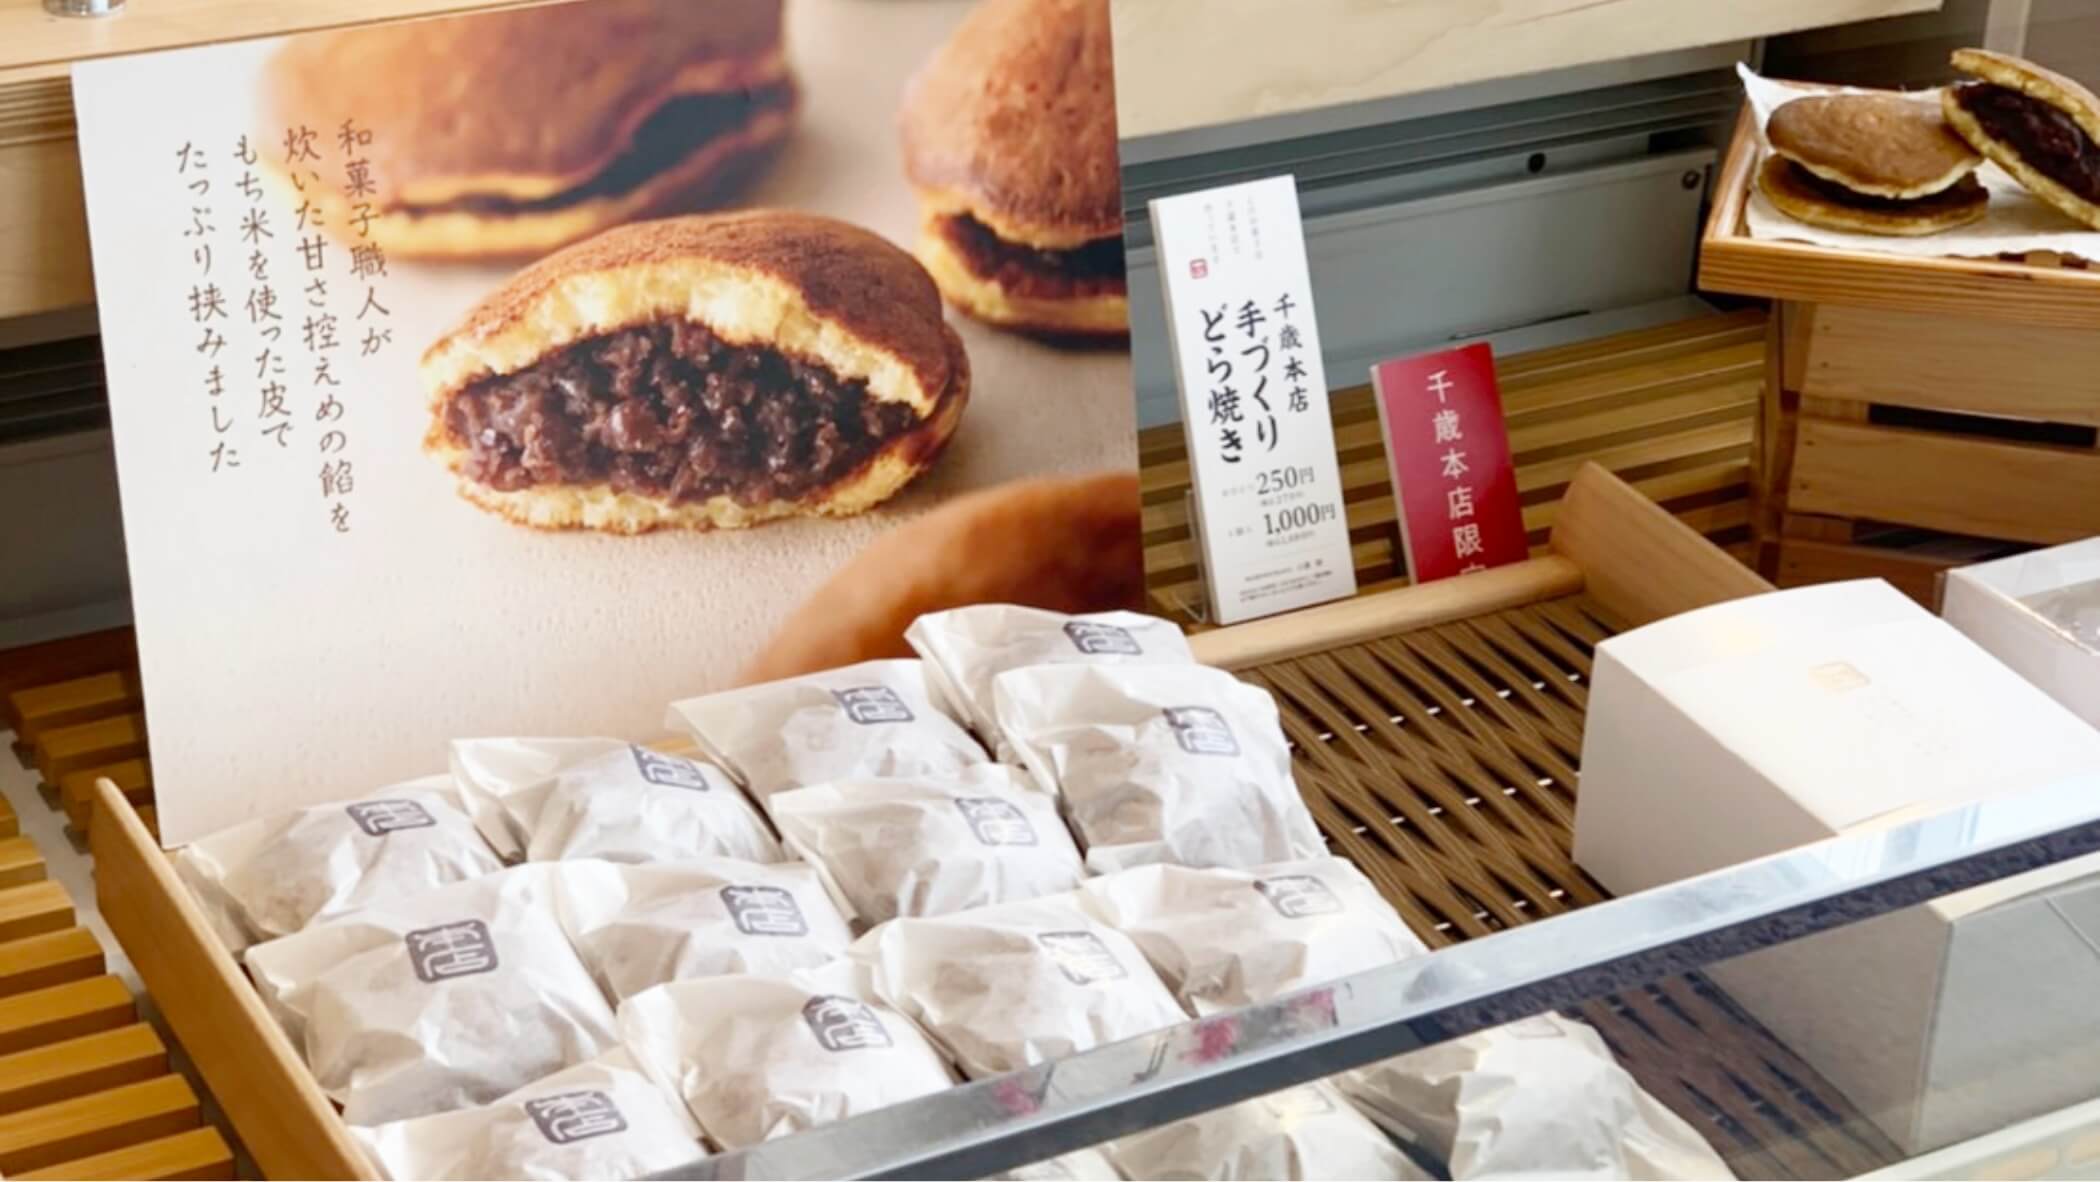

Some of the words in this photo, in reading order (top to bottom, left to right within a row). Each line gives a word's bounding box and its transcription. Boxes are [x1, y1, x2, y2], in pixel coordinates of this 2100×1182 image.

[176, 140, 241, 473] たっぷり挟みました
[233, 133, 293, 448] もち米を使った皮で
[337, 117, 393, 357] 和菓子職人が
[283, 125, 354, 533] 炊いた甘さ控えめの餡を
[1200, 302, 1244, 464] どら焼き
[1235, 299, 1279, 453] 手づくり
[1273, 291, 1310, 414] 千歳本店
[1256, 466, 1315, 495] 250円
[1264, 502, 1336, 535] 1,000円
